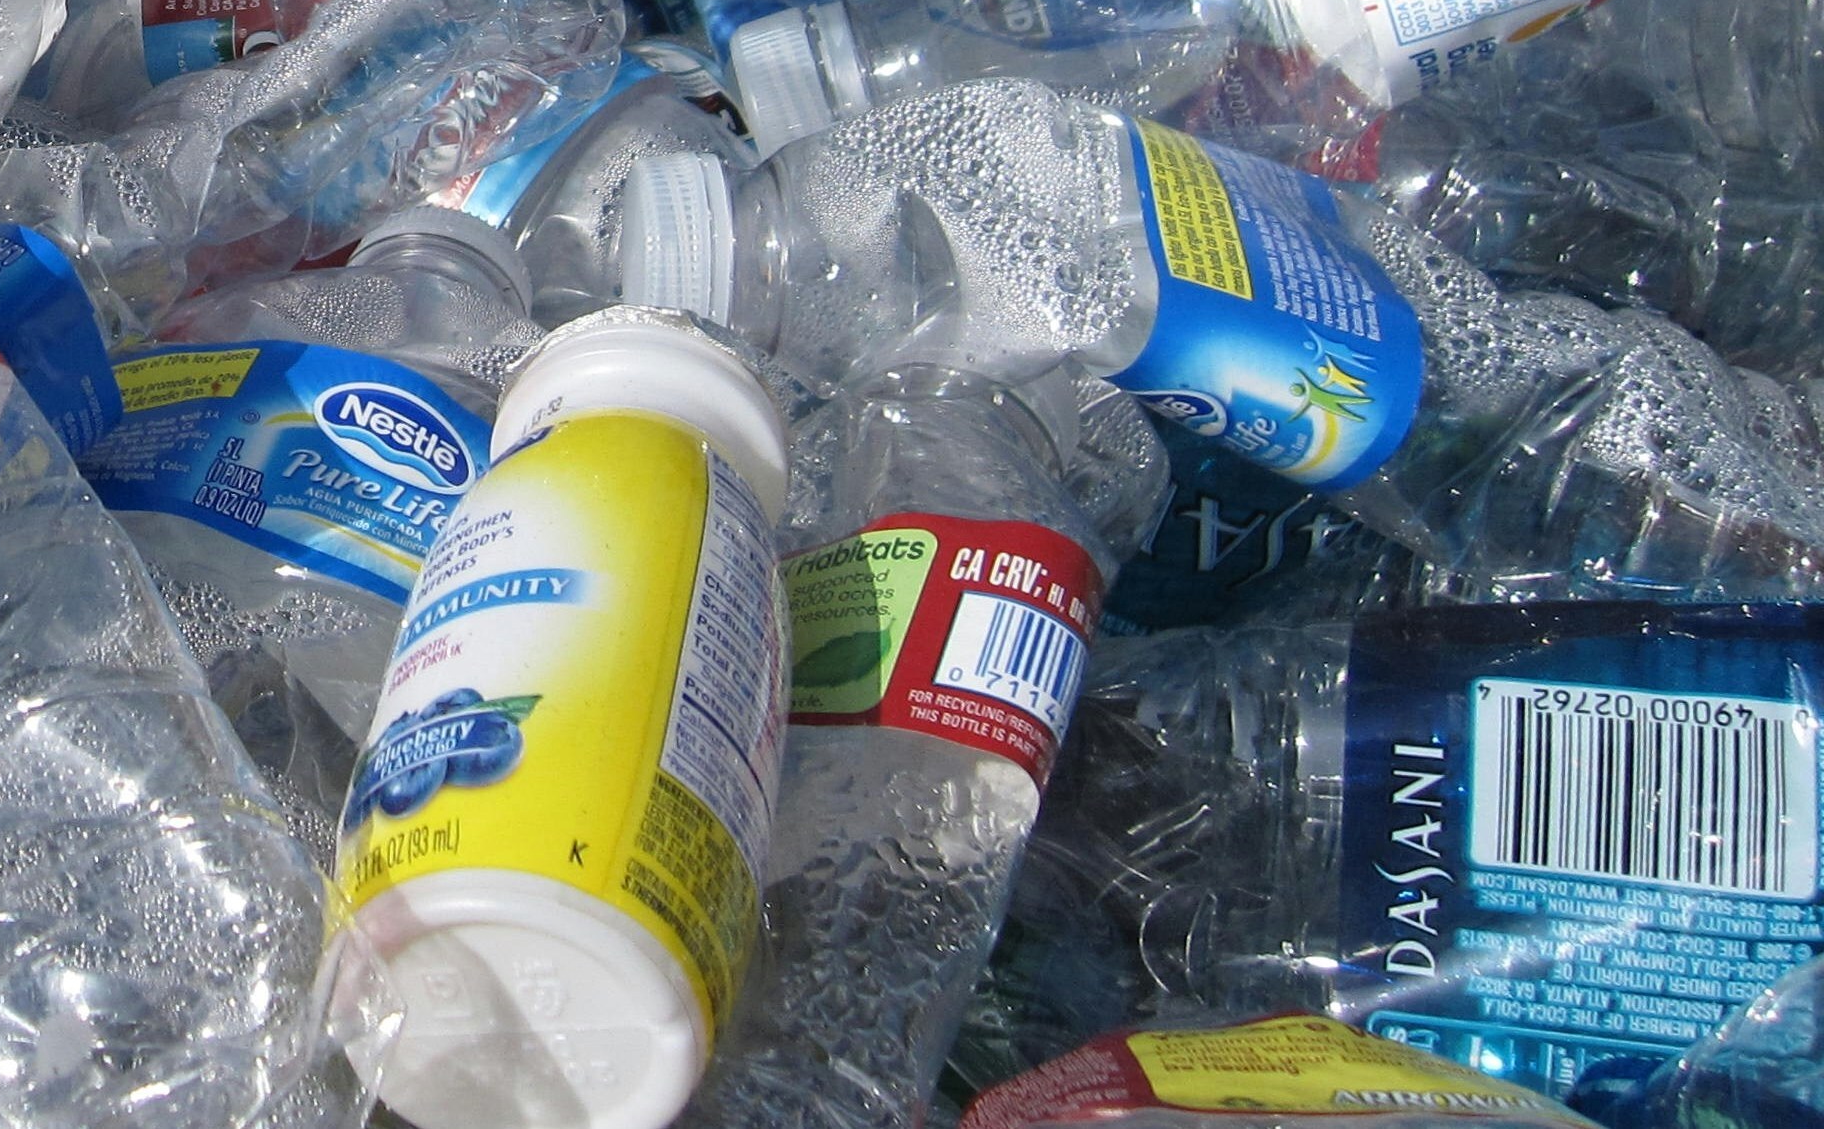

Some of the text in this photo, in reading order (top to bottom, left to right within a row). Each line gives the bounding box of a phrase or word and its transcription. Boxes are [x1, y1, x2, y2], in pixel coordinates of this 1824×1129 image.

[1394, 2, 1416, 37] CCDA
[282, 449, 381, 502] Pure
[304, 486, 424, 541] AGUA PURIFICADA
[371, 523, 392, 539] con
[459, 526, 514, 558] BODY'S
[797, 537, 927, 577] Habitats
[950, 547, 1049, 598] CA CRV;
[838, 587, 895, 602] acres
[948, 667, 964, 683] 0
[907, 689, 934, 705] FOR
[1474, 682, 1753, 728] 49000 02762 4
[909, 705, 1006, 744] THIS BOTTLE IS
[374, 718, 476, 771] Blueberry
[387, 817, 462, 868] OZ (93 mL)
[1372, 743, 1455, 977] DASANI
[1470, 870, 1662, 905] VISIT WWW.DASANI.COM
[1477, 888, 1536, 909] PLEASE
[1697, 912, 1762, 934] QUALITY
[1769, 920, 1814, 938] WATER
[1718, 938, 1747, 955] THE
[1553, 962, 1722, 994] UNDER AUTHORITY OF
[1480, 998, 1696, 1036] MEMBER OF THE COCA-COLA
